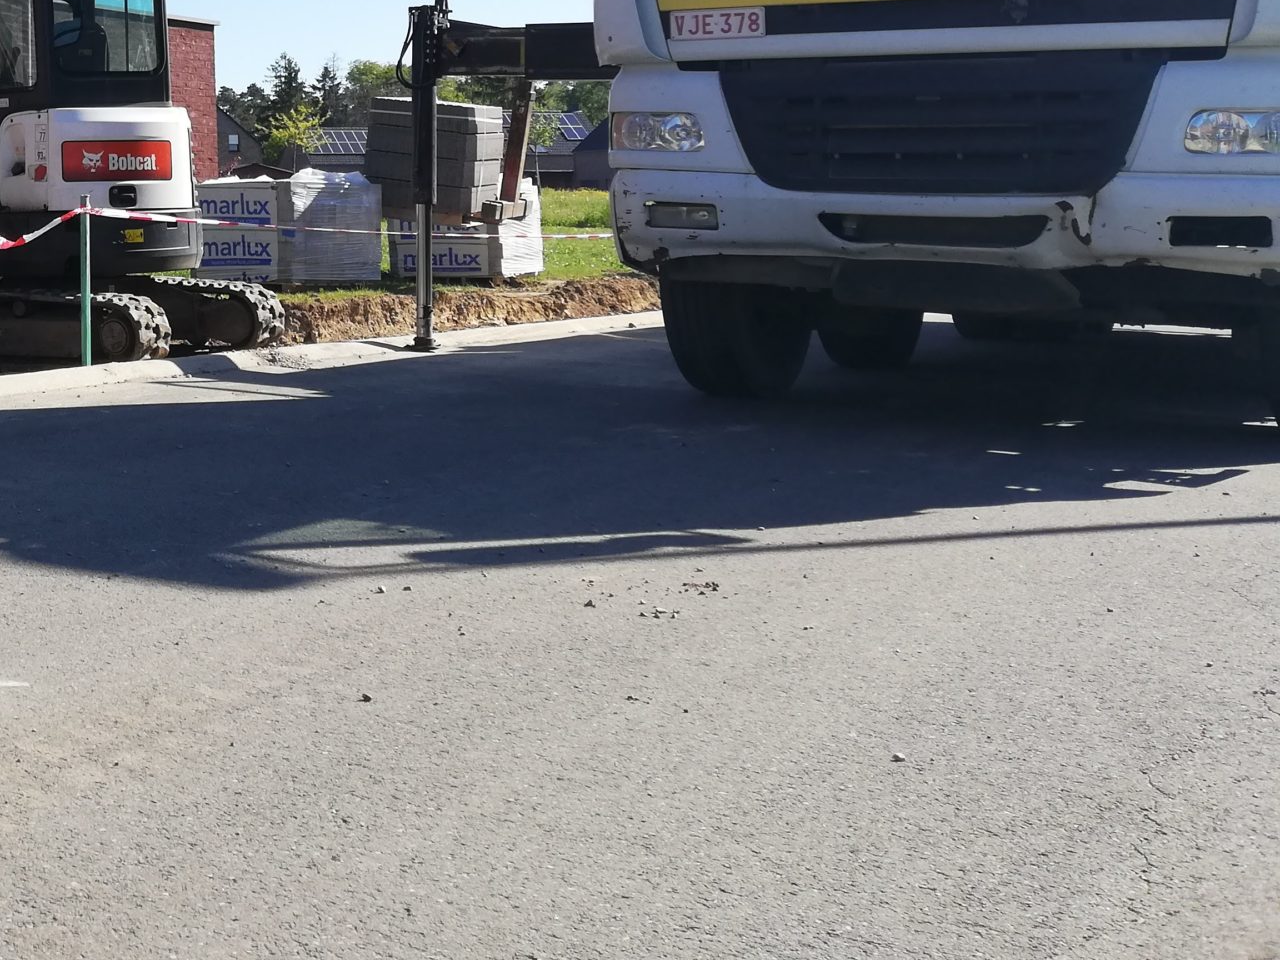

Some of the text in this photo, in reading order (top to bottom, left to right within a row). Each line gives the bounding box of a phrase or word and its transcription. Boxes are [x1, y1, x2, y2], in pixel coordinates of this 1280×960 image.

[108, 153, 158, 171] Bobcat
[200, 193, 270, 215] marlux
[203, 234, 272, 257] marlux
